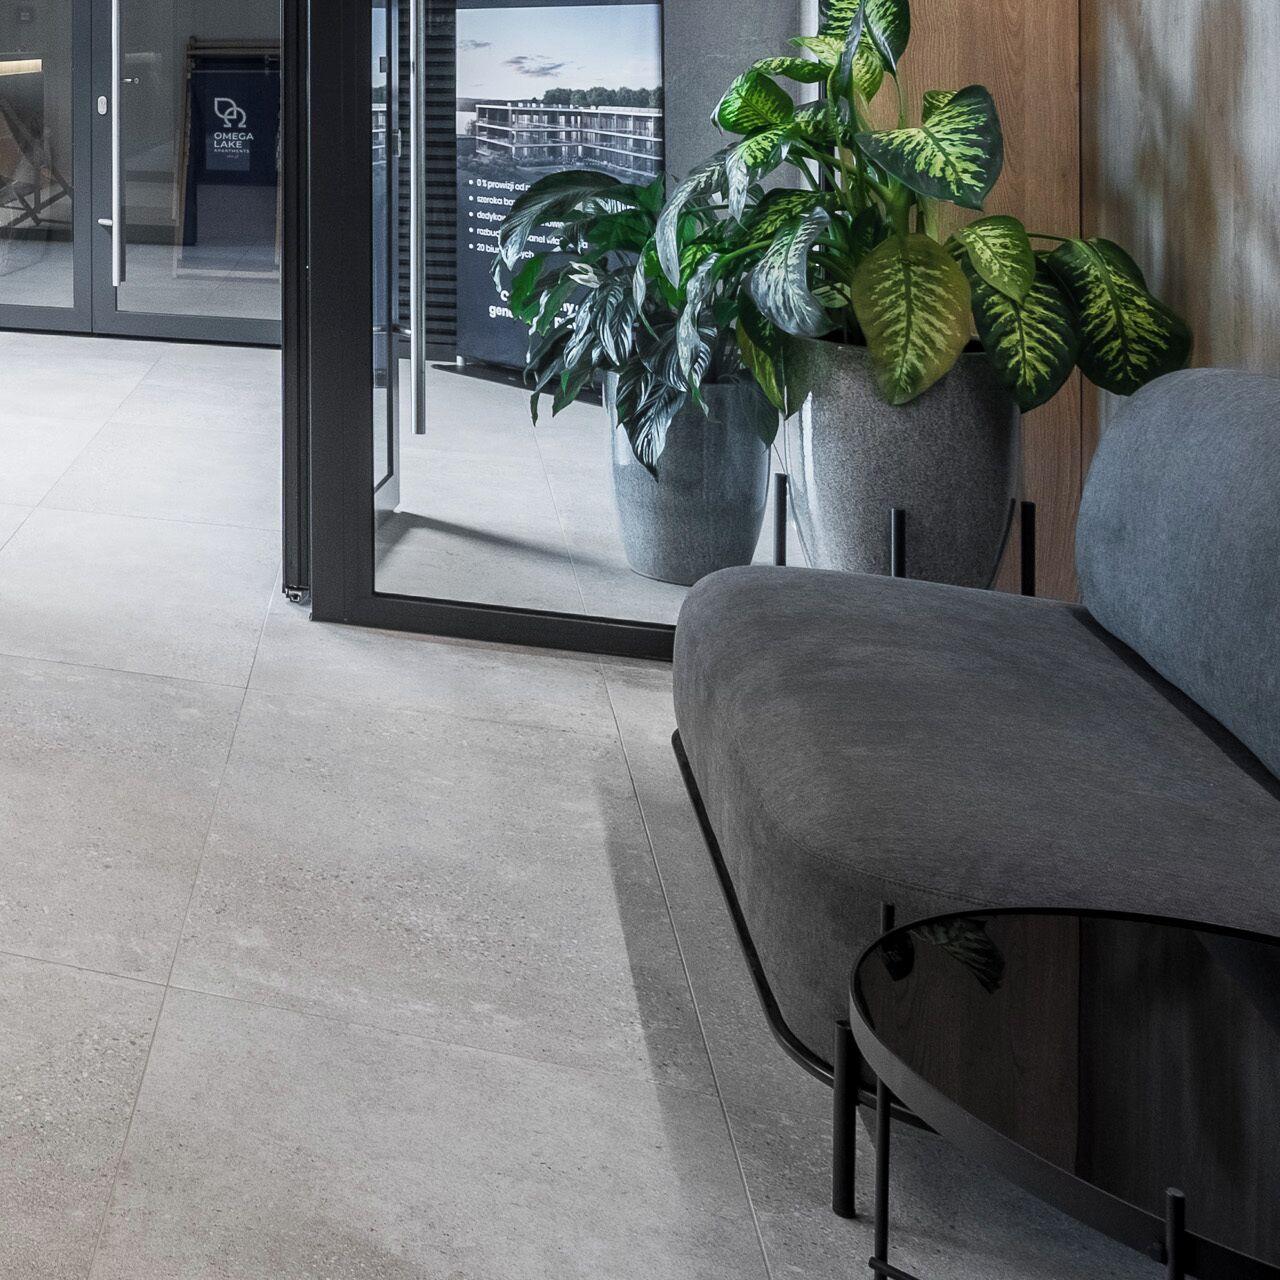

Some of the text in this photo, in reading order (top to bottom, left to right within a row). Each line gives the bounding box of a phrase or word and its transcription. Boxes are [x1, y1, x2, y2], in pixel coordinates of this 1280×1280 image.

[213, 131, 254, 141] OMEGA
[213, 140, 243, 148] LAKE
[487, 180, 515, 192] prowizji
[515, 183, 525, 191] od
[477, 195, 503, 205] szeroka
